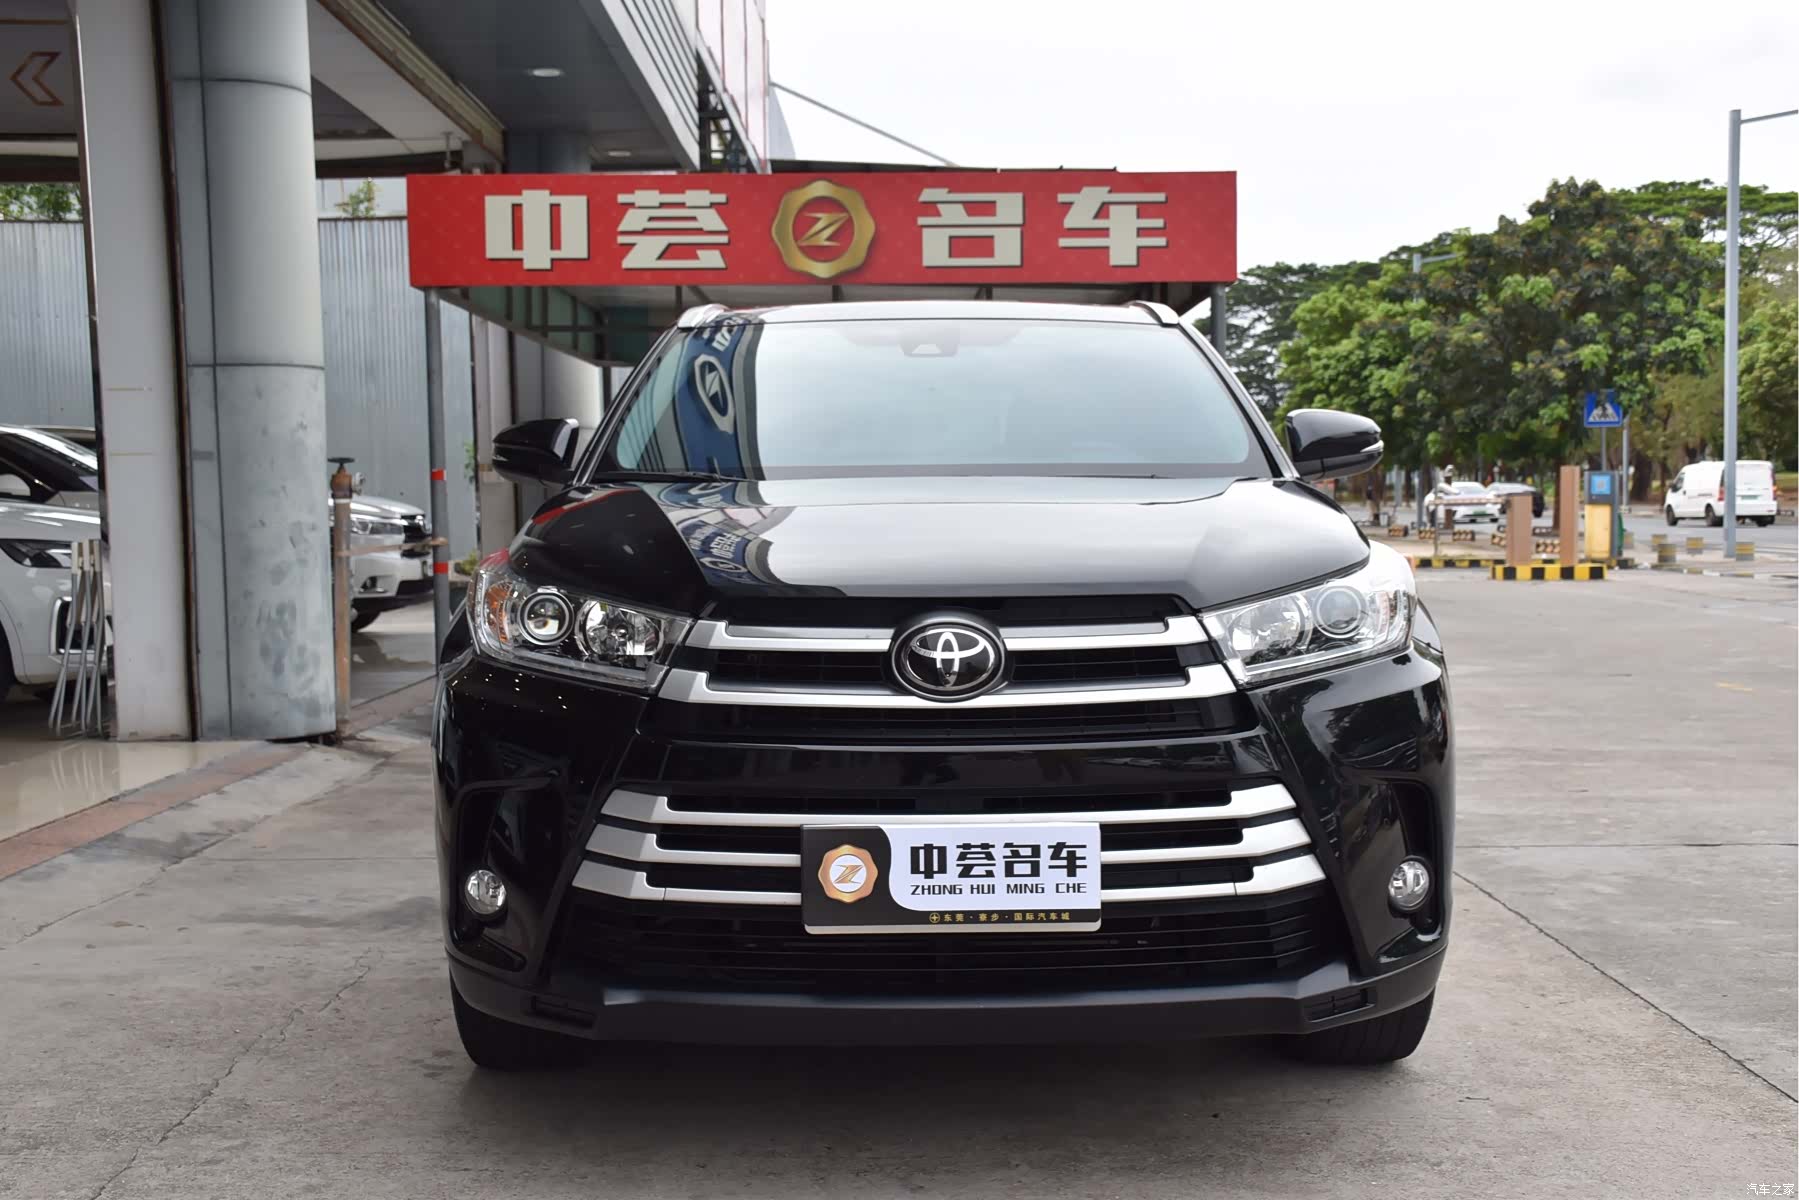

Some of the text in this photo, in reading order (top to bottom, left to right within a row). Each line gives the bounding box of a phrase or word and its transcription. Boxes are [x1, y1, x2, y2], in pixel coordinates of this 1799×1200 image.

[484, 186, 1168, 270] 中荟 名车
[910, 841, 1088, 879] 中荟名车
[910, 882, 1087, 896] ZHONG HUI MING CHE
